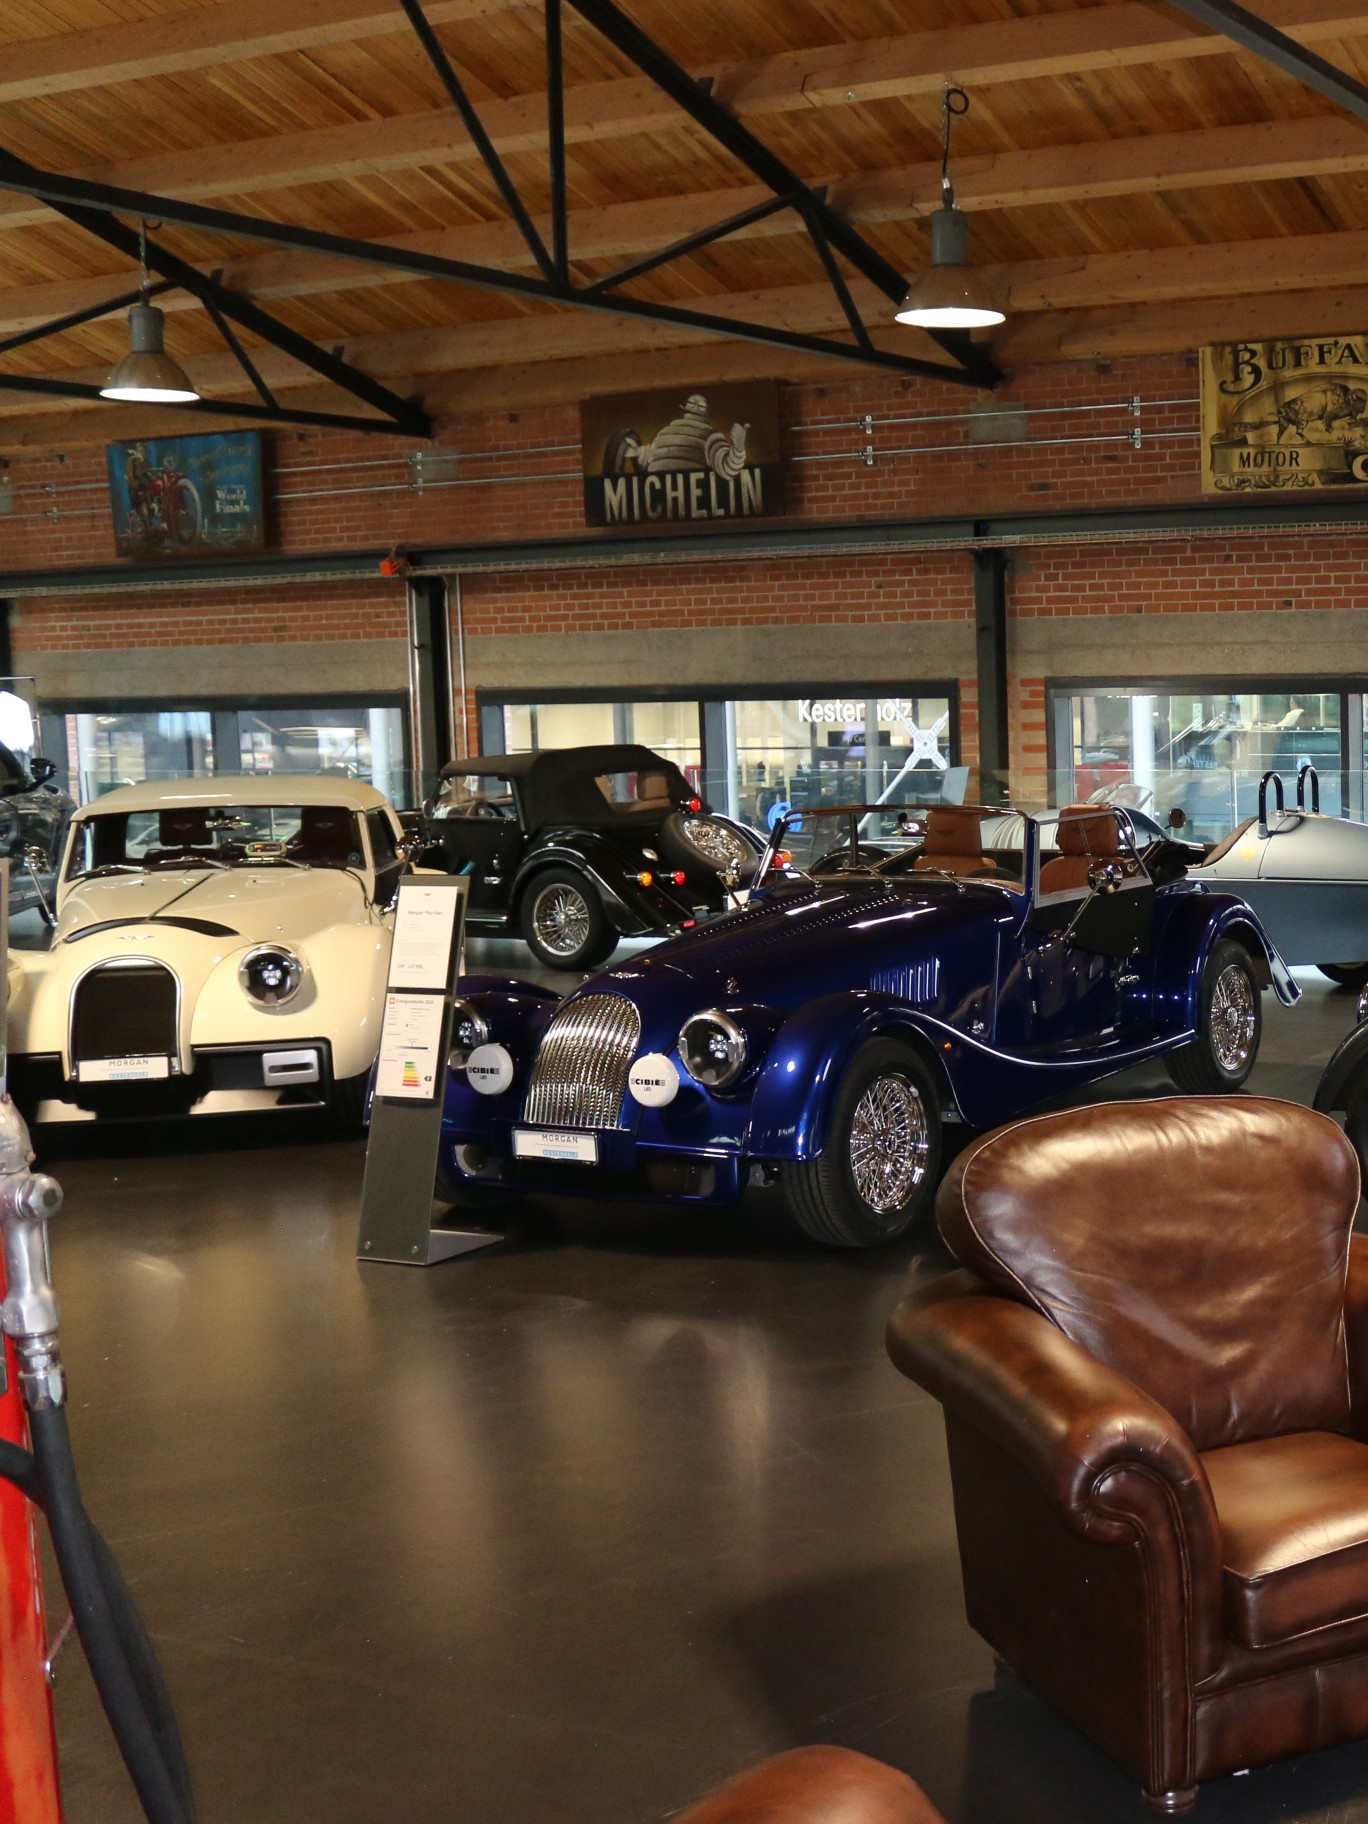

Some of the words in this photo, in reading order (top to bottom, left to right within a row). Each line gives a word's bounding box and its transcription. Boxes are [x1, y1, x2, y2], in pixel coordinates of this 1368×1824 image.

[1238, 450, 1300, 469] MOTOR
[215, 489, 247, 501] World
[603, 467, 763, 523] MICHELIN
[215, 500, 250, 513] Finals
[109, 1059, 149, 1067] MORGAN
[541, 1133, 578, 1144] MORGAN
